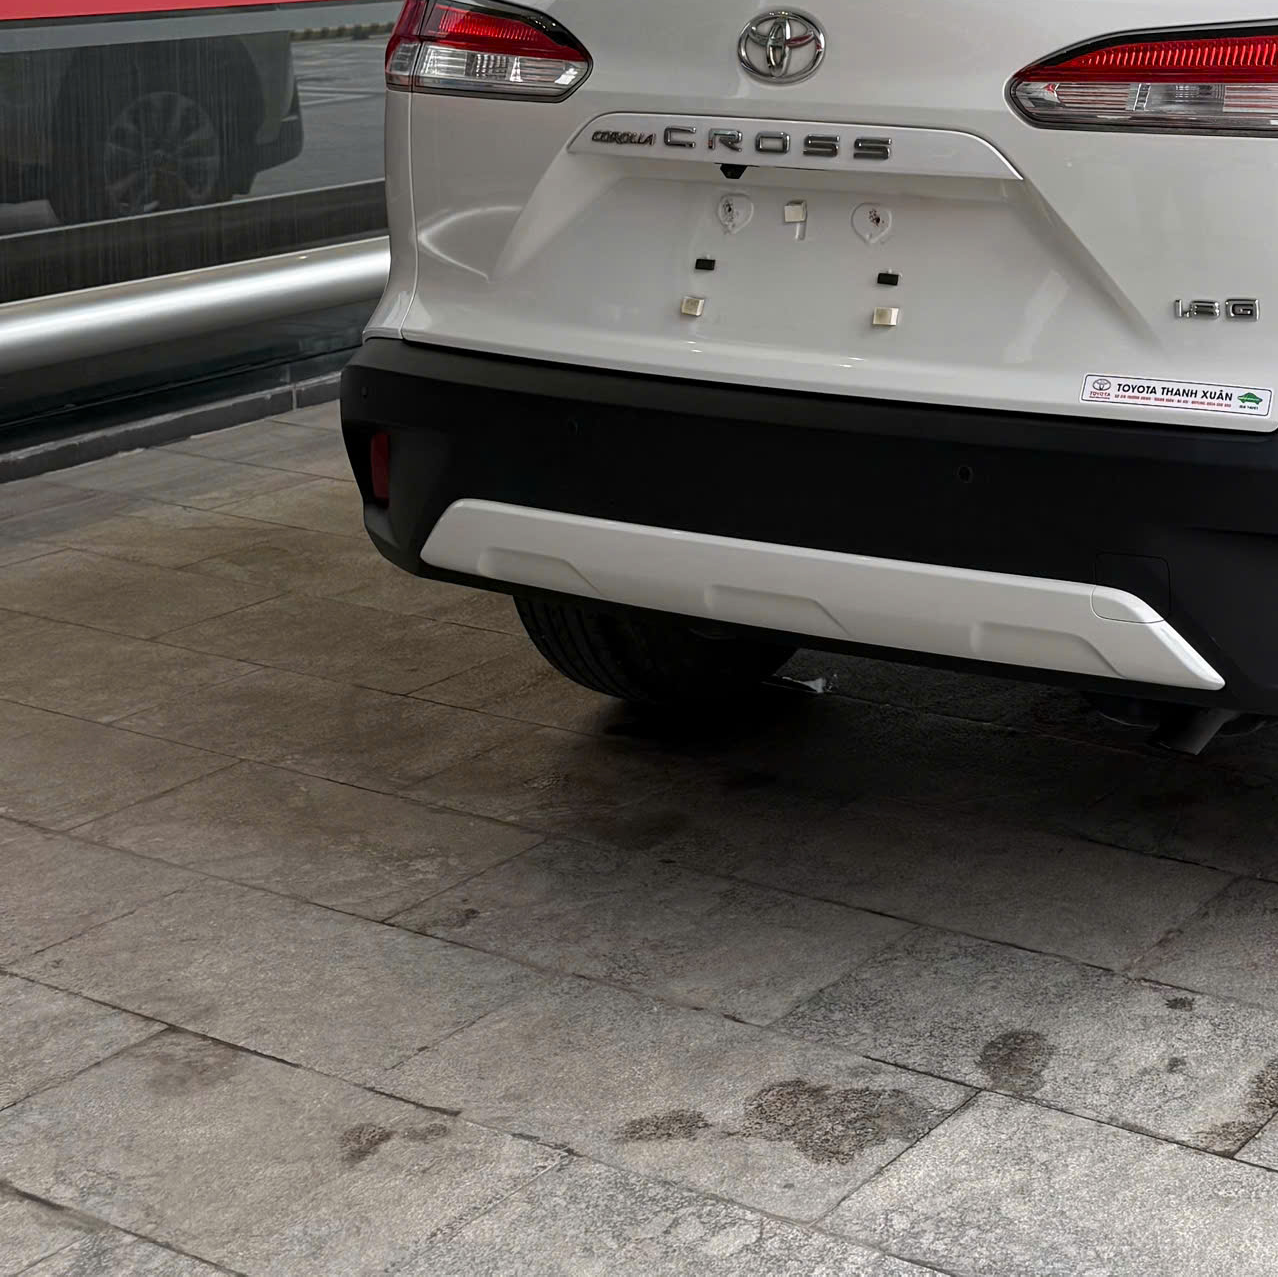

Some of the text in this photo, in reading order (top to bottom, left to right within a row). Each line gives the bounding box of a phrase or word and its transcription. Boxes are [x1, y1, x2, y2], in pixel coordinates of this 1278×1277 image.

[592, 126, 893, 161] COROLLA CROSS
[1117, 383, 1157, 395] TOYOTA
[1161, 387, 1198, 399] THANH
[1201, 389, 1233, 402] XUÂN
